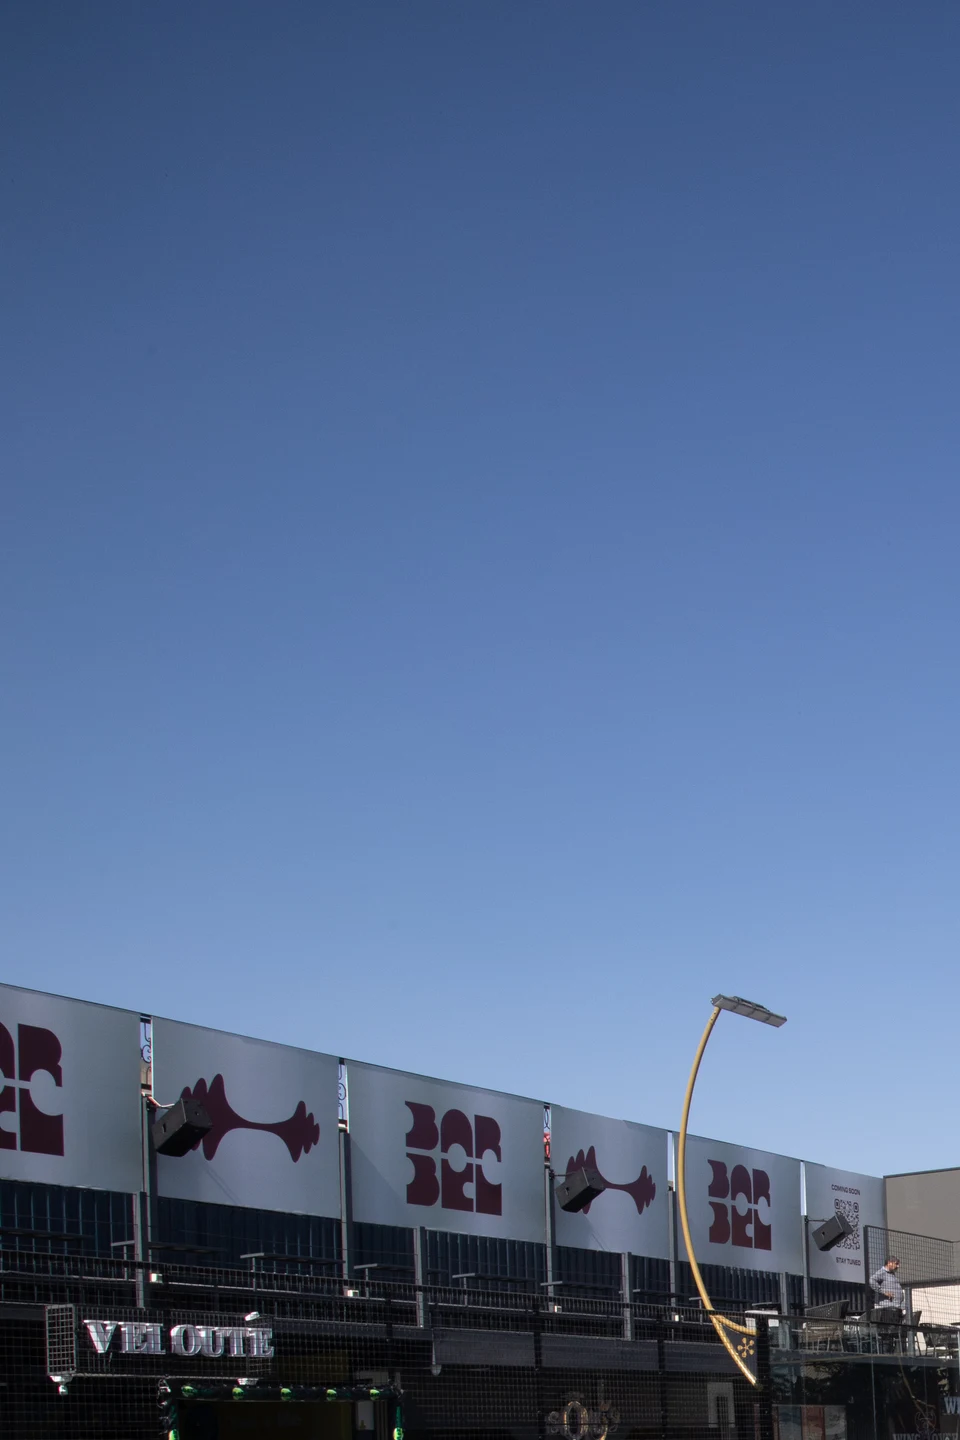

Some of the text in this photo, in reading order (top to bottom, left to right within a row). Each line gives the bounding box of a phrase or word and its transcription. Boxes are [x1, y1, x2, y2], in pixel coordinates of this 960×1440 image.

[831, 1184, 861, 1196] COMING SOON
[847, 1258, 861, 1266] TUNED
